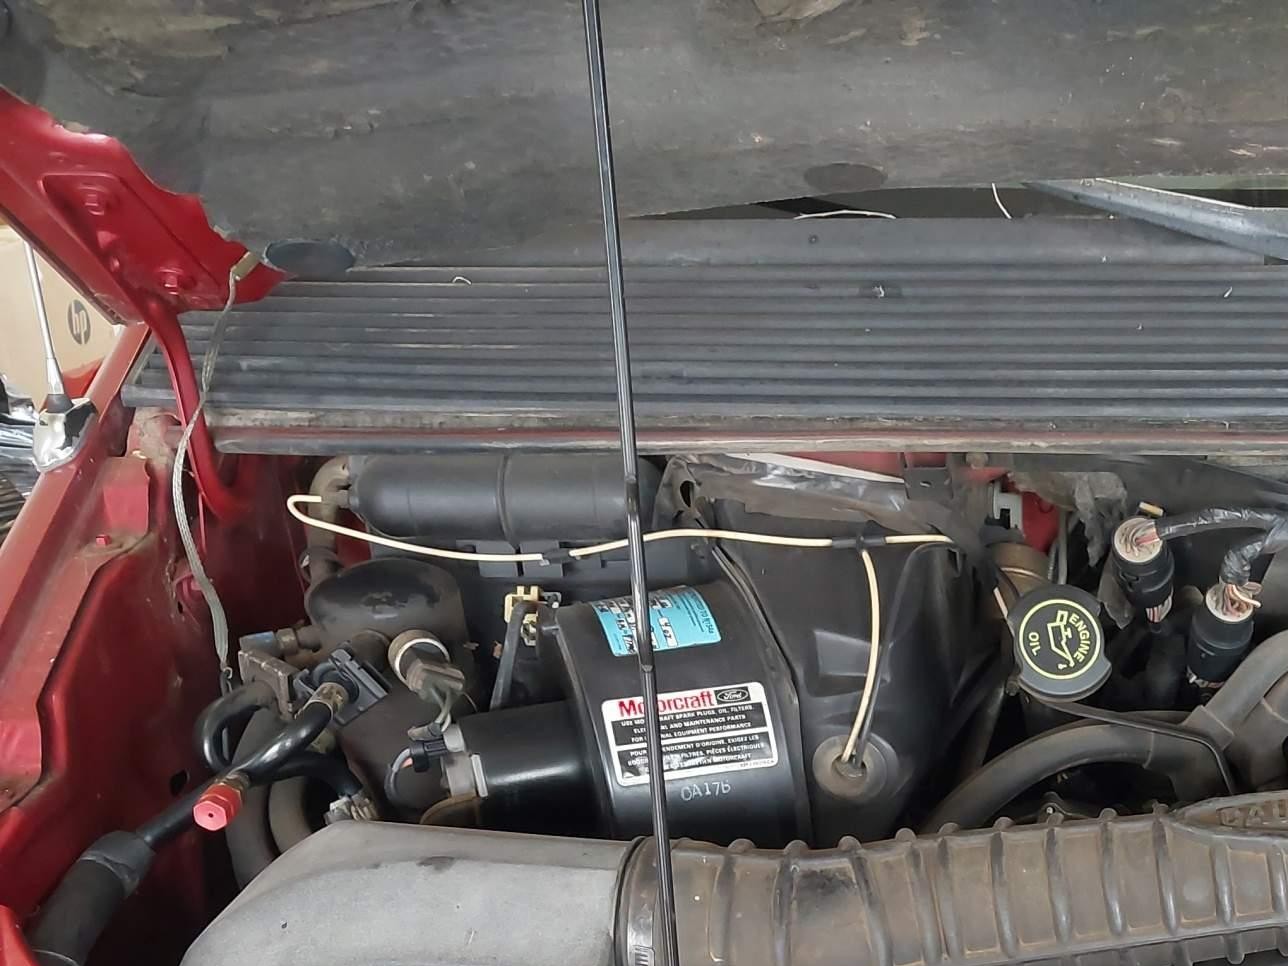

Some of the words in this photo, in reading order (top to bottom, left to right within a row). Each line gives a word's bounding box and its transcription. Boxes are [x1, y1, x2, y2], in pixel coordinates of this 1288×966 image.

[70, 301, 88, 345] hp
[1028, 631, 1041, 656] OIL
[1069, 612, 1091, 663] ENGINE
[618, 690, 715, 717] Moorcraft
[670, 722, 682, 730] AND
[684, 717, 726, 727] MAINTENANCE
[675, 712, 695, 720] SPARK
[674, 728, 708, 738] EQUIPMENT
[709, 722, 751, 733] PERFORMANCE
[662, 743, 694, 752] ENDEMENT
